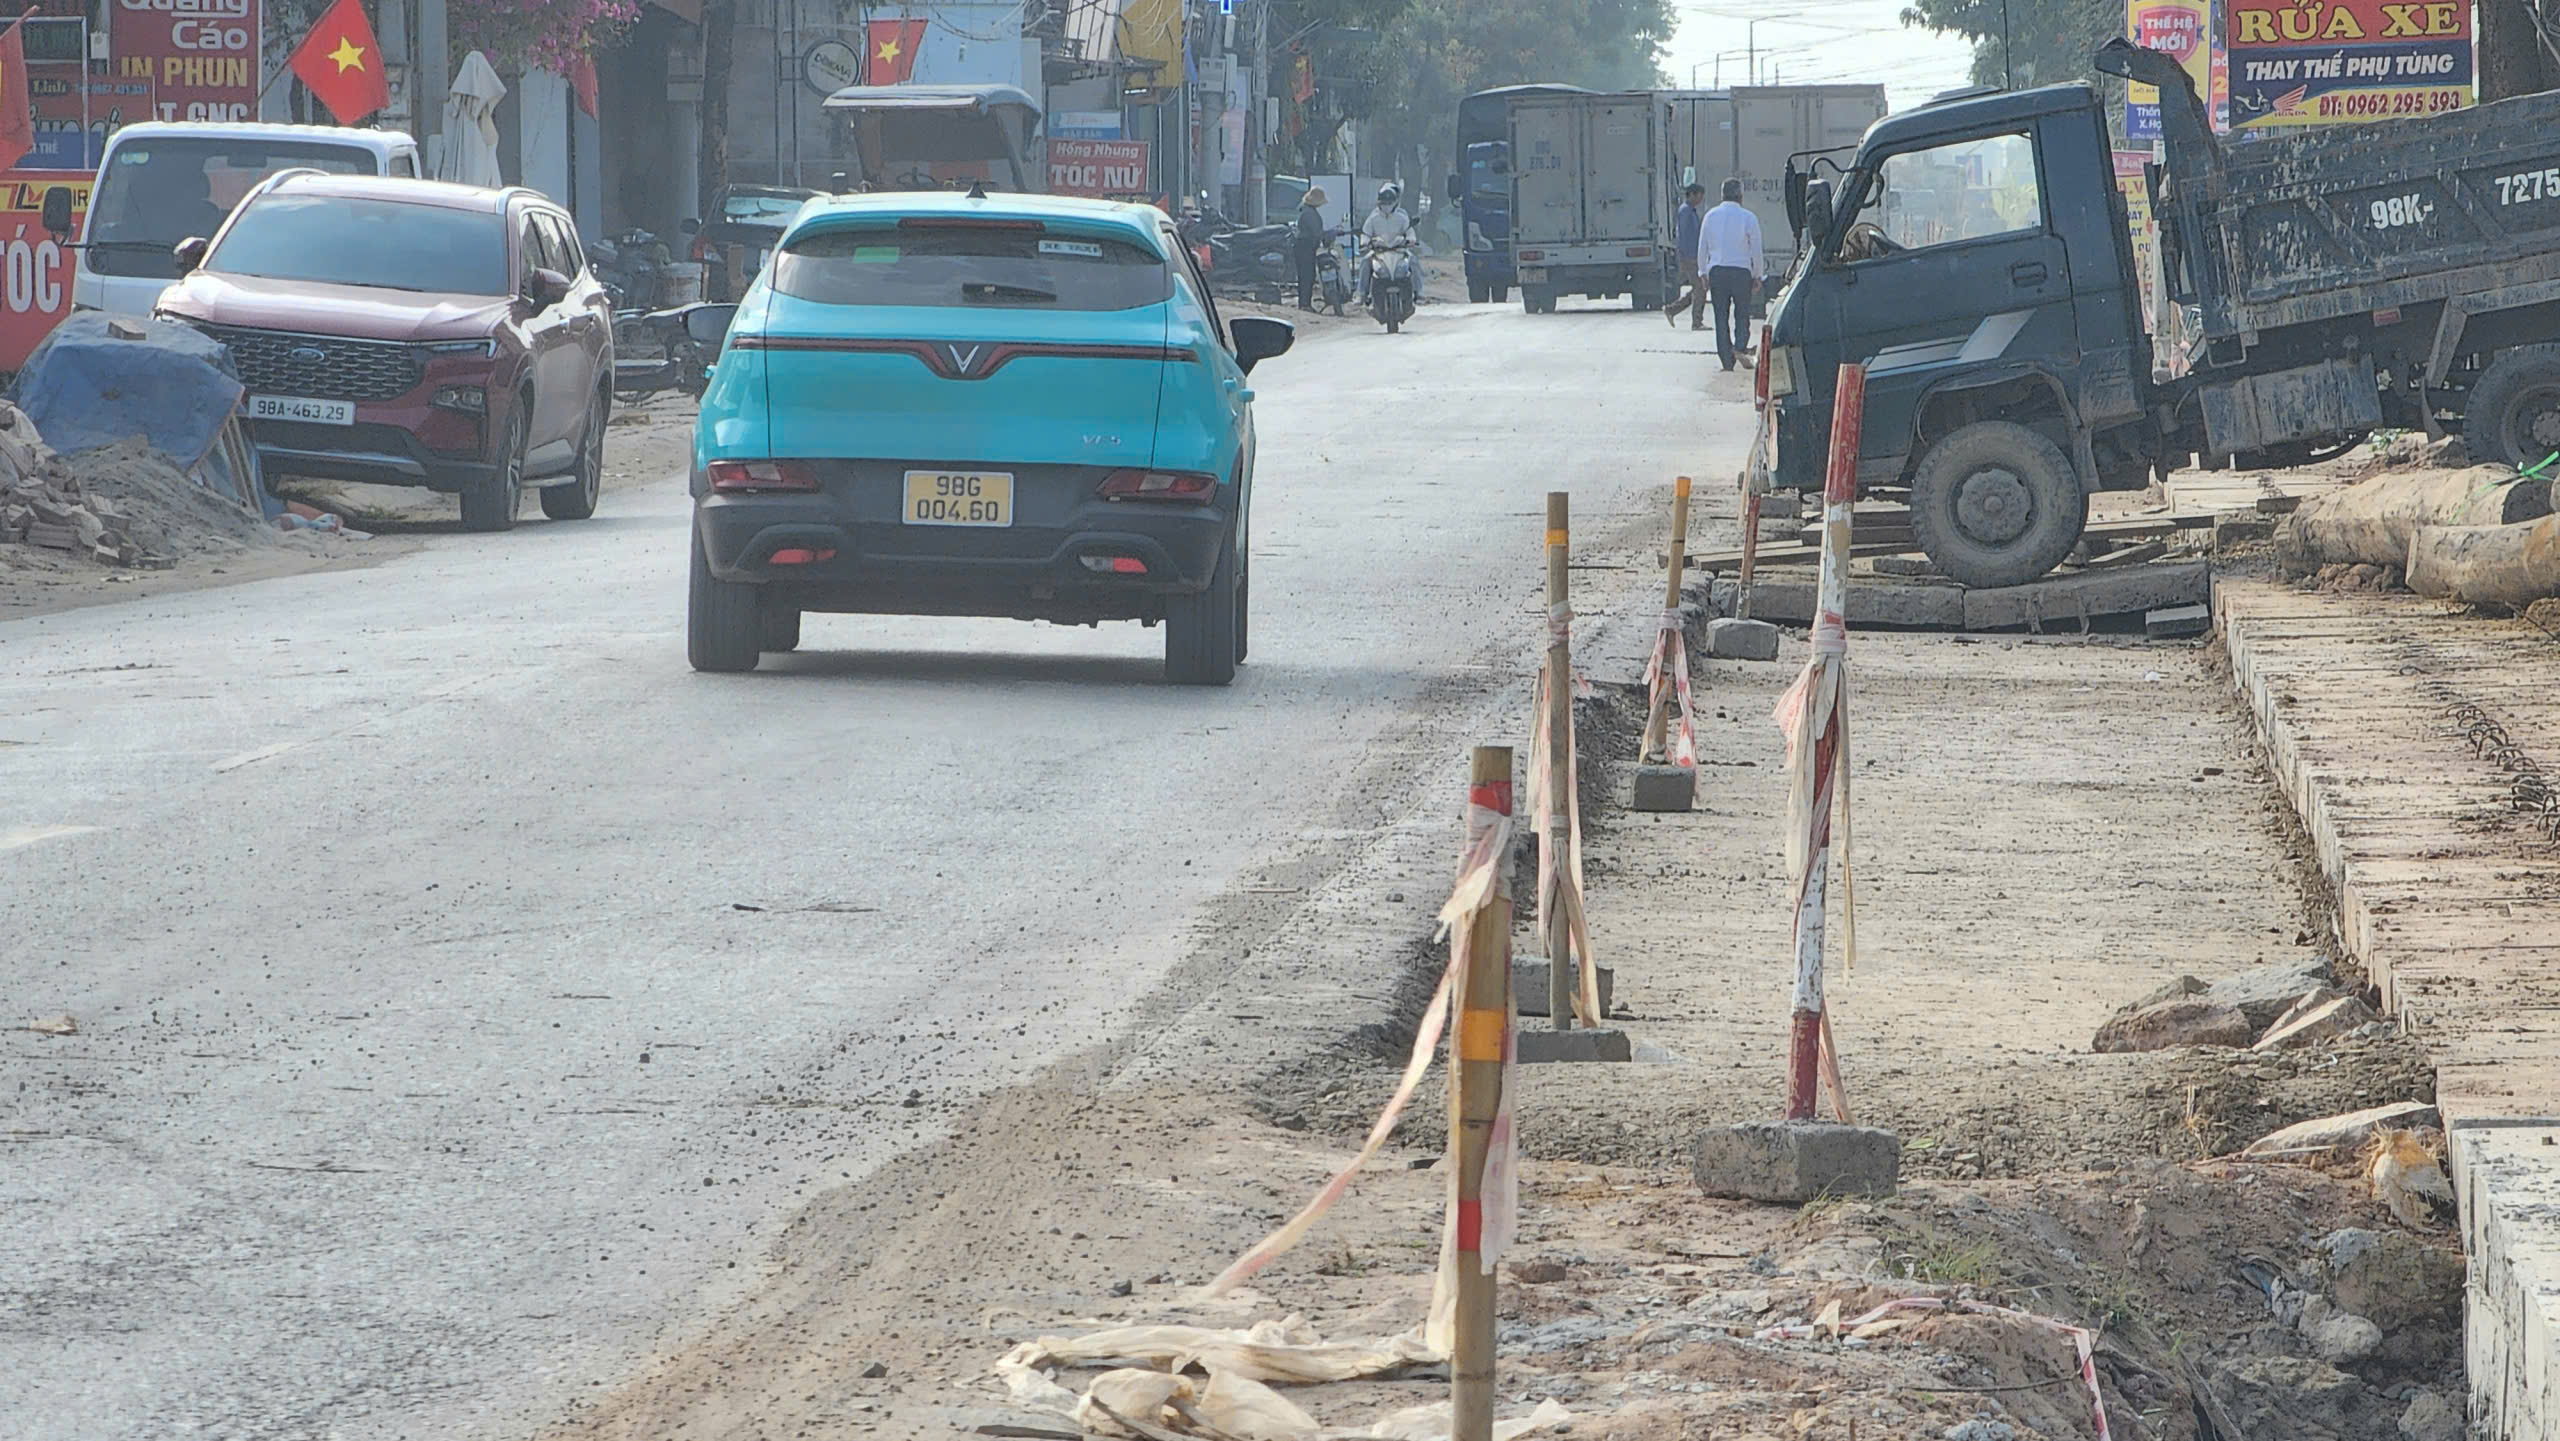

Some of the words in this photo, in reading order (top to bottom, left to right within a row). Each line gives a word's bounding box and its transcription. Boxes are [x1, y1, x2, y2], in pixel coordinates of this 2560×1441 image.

[172, 20, 248, 49] Cáo
[2144, 14, 2172, 29] THẾ
[2174, 15, 2193, 31] HỆ
[2236, 0, 2366, 43] RỬA
[2379, 3, 2461, 37] XE
[2150, 31, 2188, 50] MỚI
[120, 57, 152, 77] IN
[164, 58, 248, 87] PHUN
[2246, 60, 2300, 81] THAY
[2304, 50, 2344, 79] THẾ
[2346, 57, 2391, 81] PHỤ
[2396, 51, 2455, 76] TÙNG
[2319, 95, 2342, 116] ĐT:
[2346, 93, 2388, 115] 0962
[2392, 92, 2423, 113] 295
[2428, 90, 2461, 110] 393
[1056, 141, 1091, 156] Hồng
[1094, 143, 1139, 158] Nhung
[1051, 161, 1096, 187] TÓC
[1103, 162, 1142, 188] NỮ
[2371, 193, 2434, 229] 98K-
[257, 400, 345, 420] 98A-463.29
[936, 476, 981, 497] 98G
[916, 500, 999, 521] 004.60
